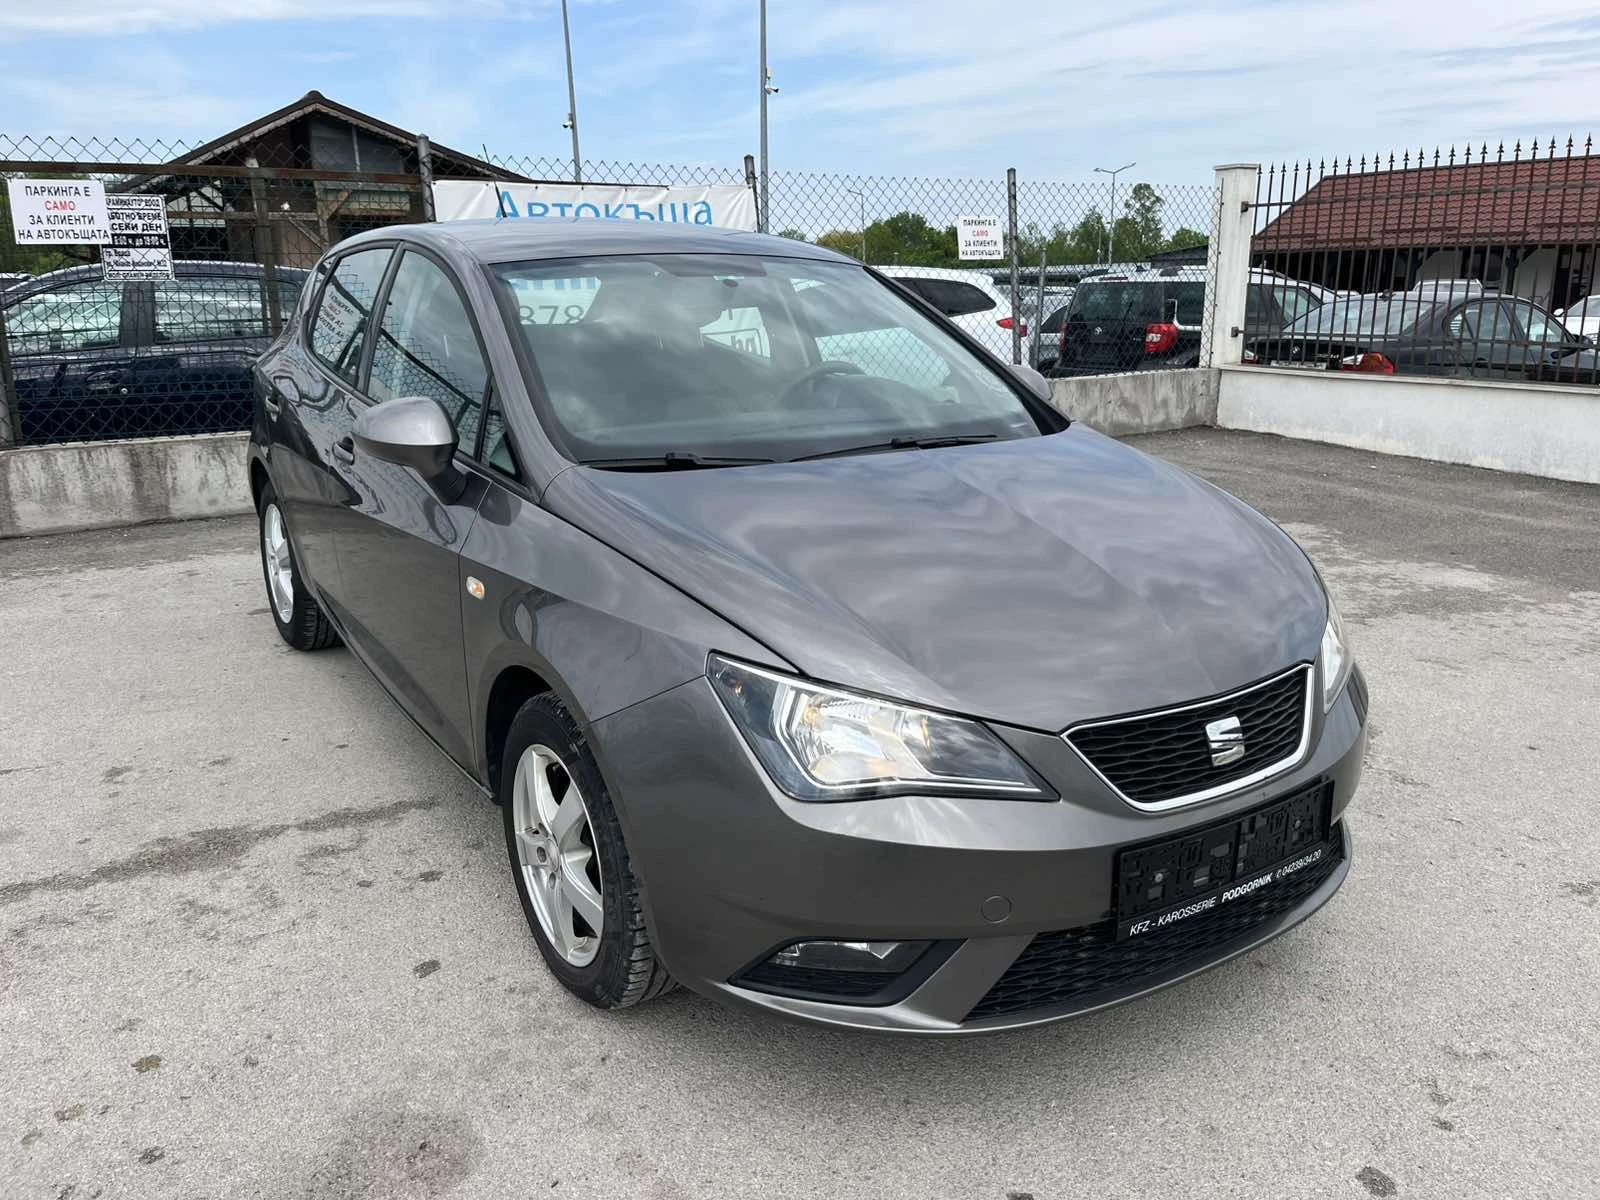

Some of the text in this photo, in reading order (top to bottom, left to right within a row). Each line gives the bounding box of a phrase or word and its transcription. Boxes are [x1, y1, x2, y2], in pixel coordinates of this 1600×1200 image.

[25, 186, 91, 197] ПАРКИНГА Е
[44, 200, 76, 211] САМО
[28, 215, 95, 225] ЗА КЛИЕНТИ
[142, 224, 162, 232] ДЕН
[18, 229, 110, 241] НА АВТОКЪЩАТА
[1130, 920, 1150, 937] KFZ
[1157, 896, 1217, 927] KAROSSERIE
[1222, 872, 1273, 903] PODGORNIK
